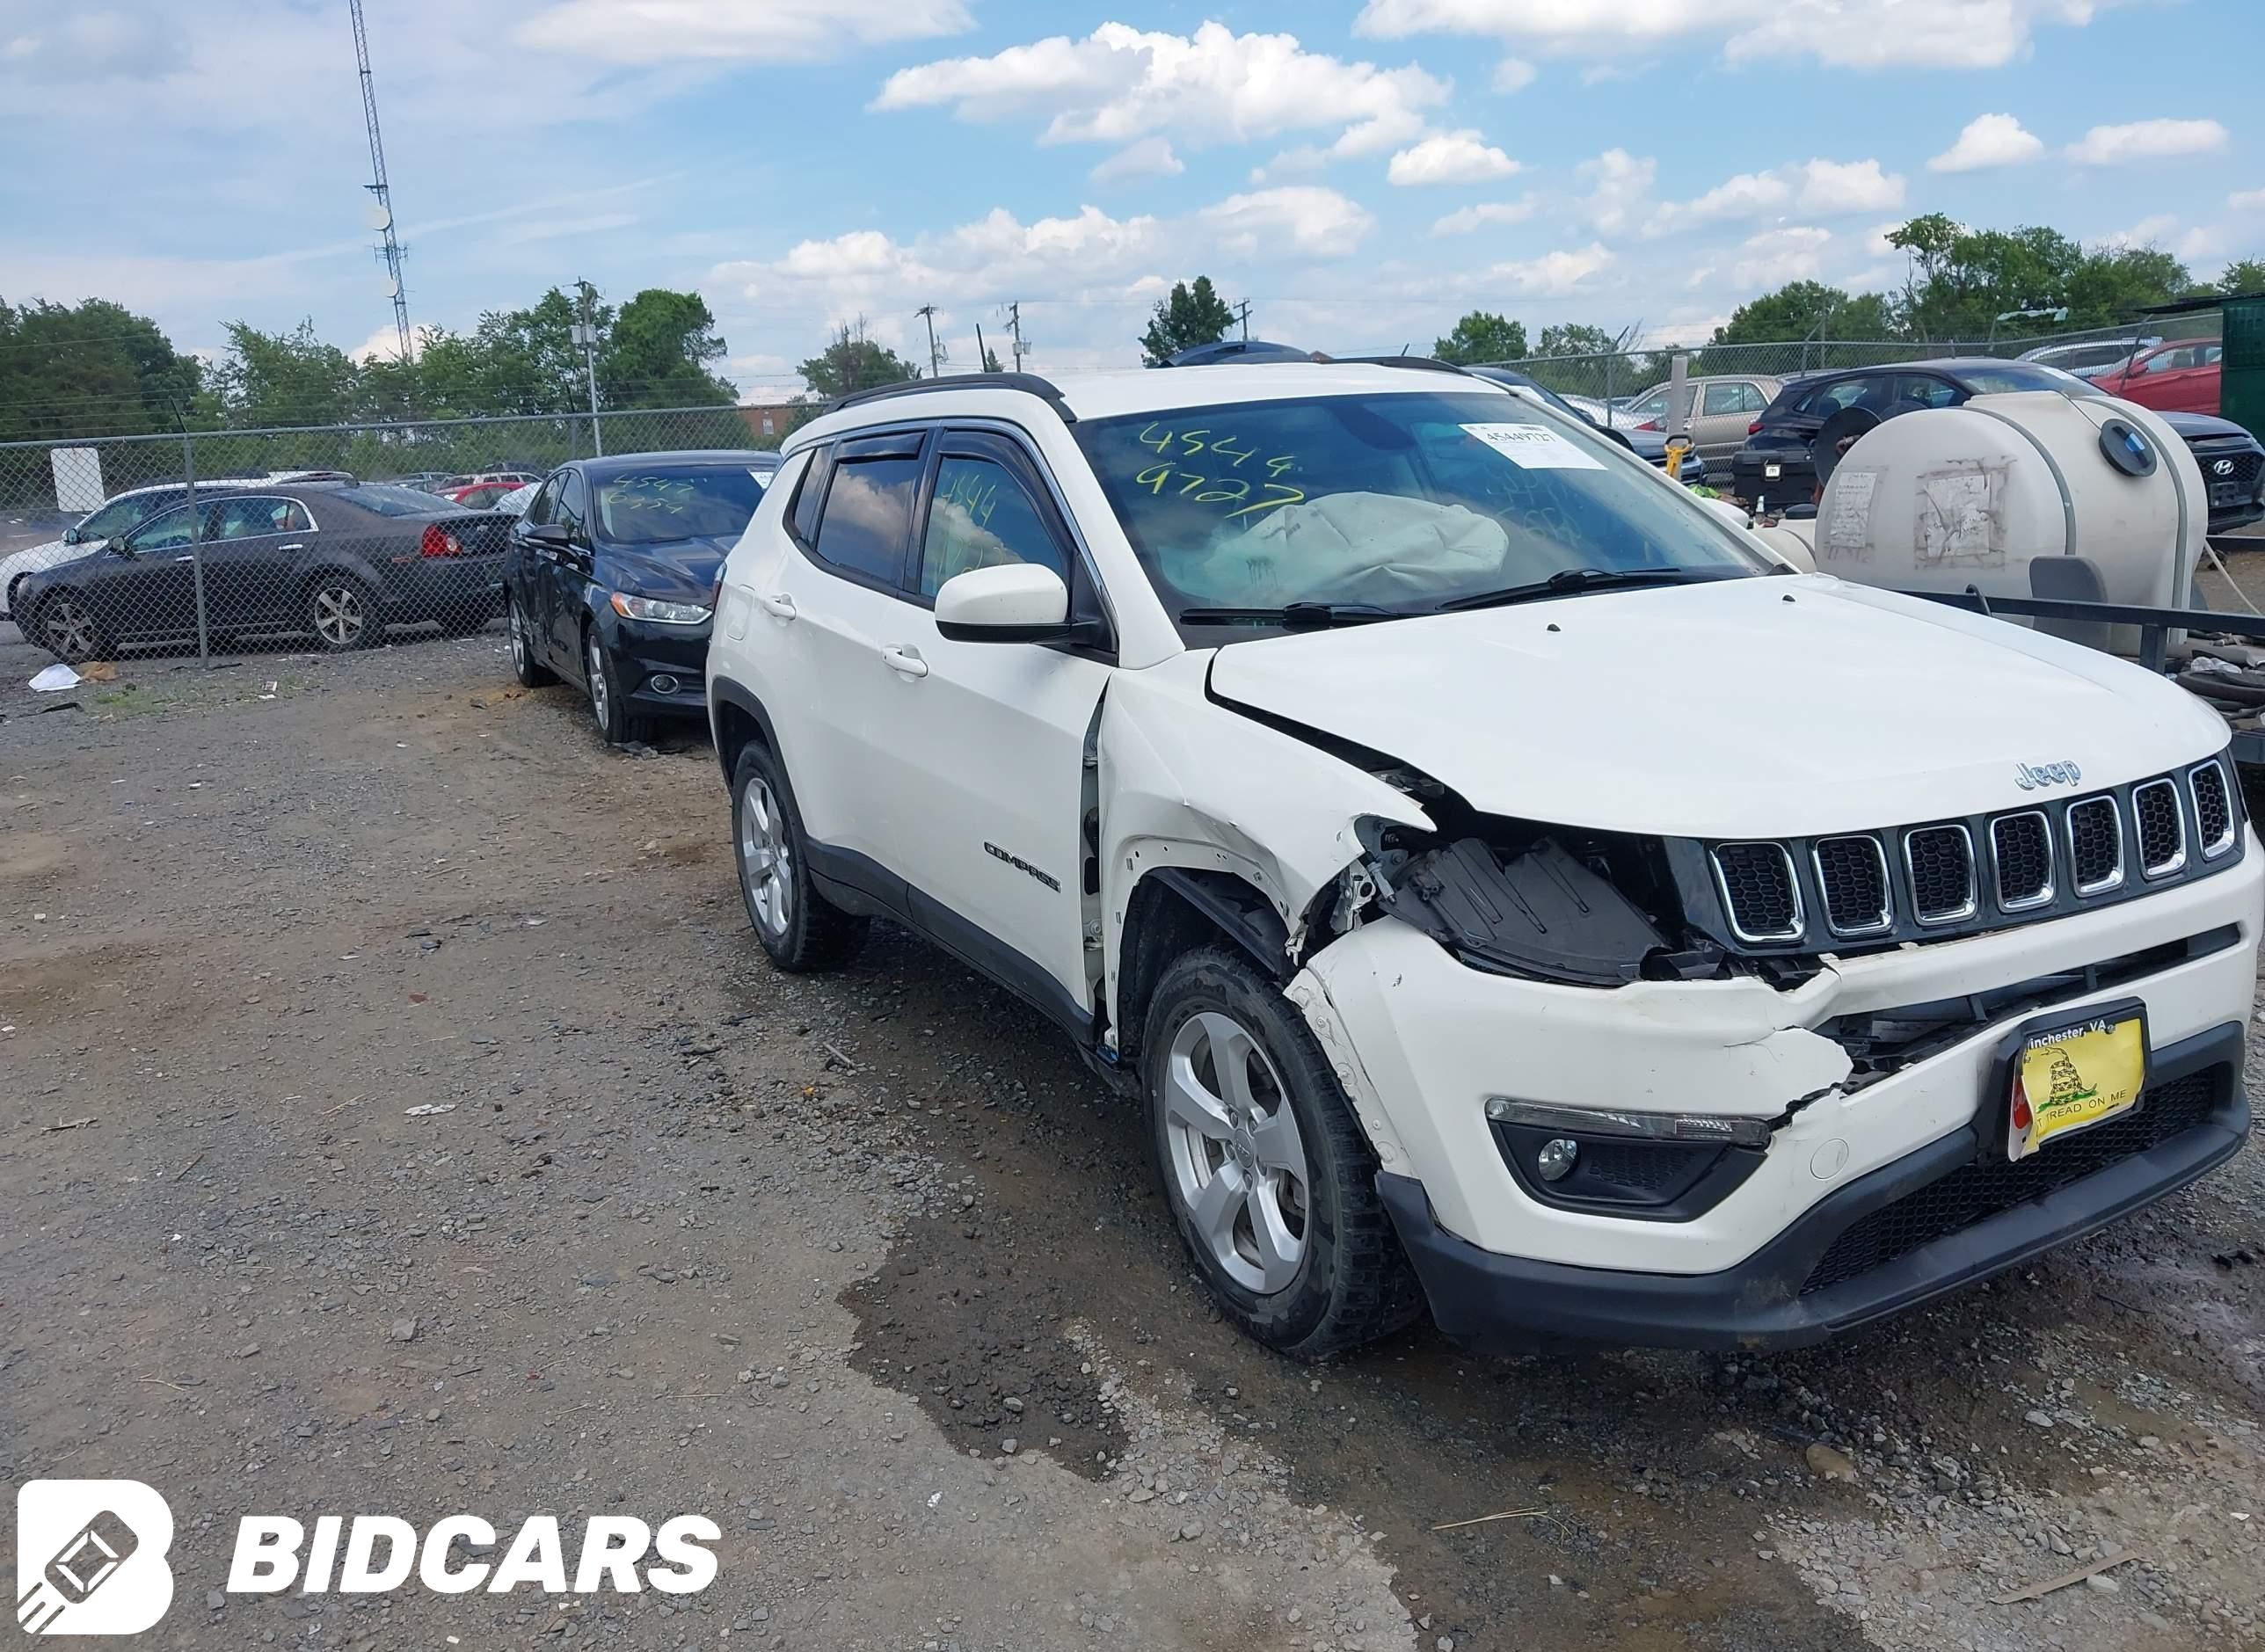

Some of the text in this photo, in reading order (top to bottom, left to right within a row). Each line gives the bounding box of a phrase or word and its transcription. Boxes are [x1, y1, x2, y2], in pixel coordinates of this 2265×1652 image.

[1140, 420, 1297, 478] 4544
[1136, 460, 1305, 519] 9727
[2014, 761, 2081, 790] Jeep
[984, 841, 1061, 893] COMPASS
[2088, 1096, 2106, 1109] ON
[2110, 1088, 2127, 1102] ME
